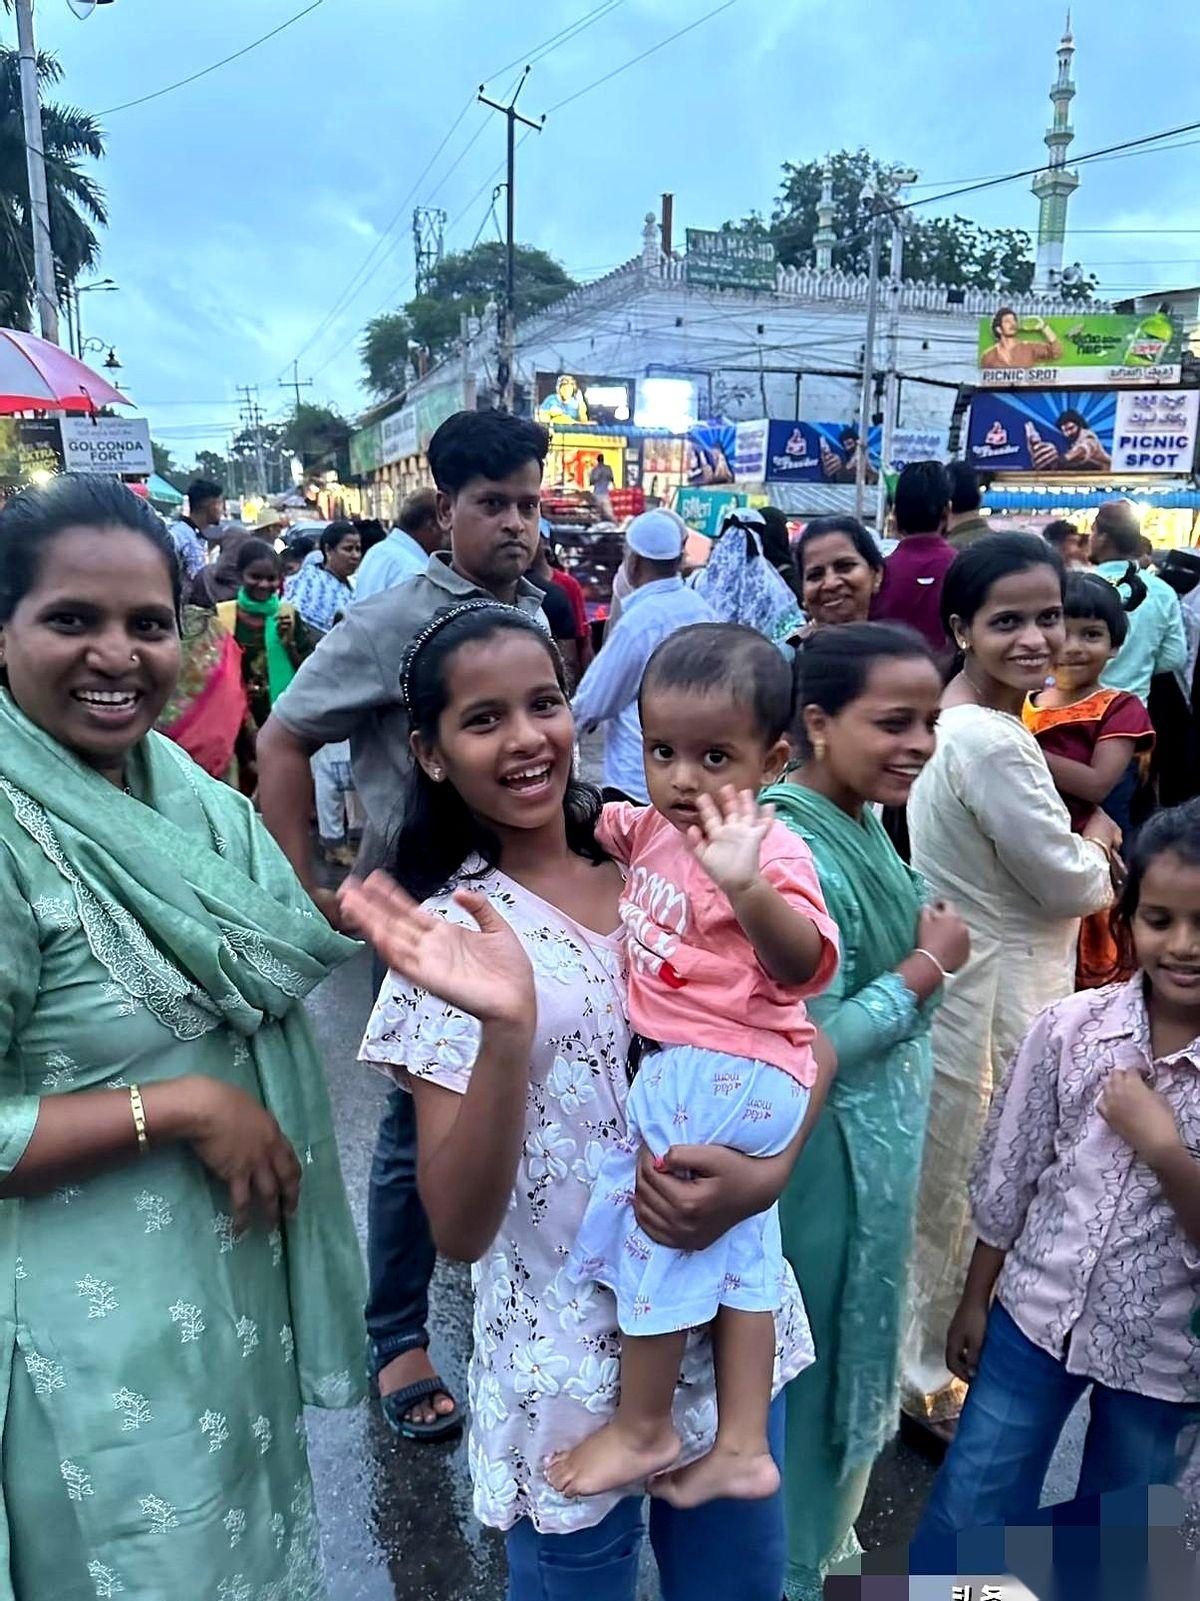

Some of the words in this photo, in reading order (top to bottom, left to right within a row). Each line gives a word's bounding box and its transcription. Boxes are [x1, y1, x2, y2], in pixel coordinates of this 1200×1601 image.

[983, 368, 1025, 381] PICNIC
[1028, 368, 1059, 381] SPOT
[68, 441, 143, 452] GOLCONDA
[1119, 435, 1189, 449] PICNIC
[90, 451, 125, 461] FORT
[1126, 453, 1179, 467] SPOT
